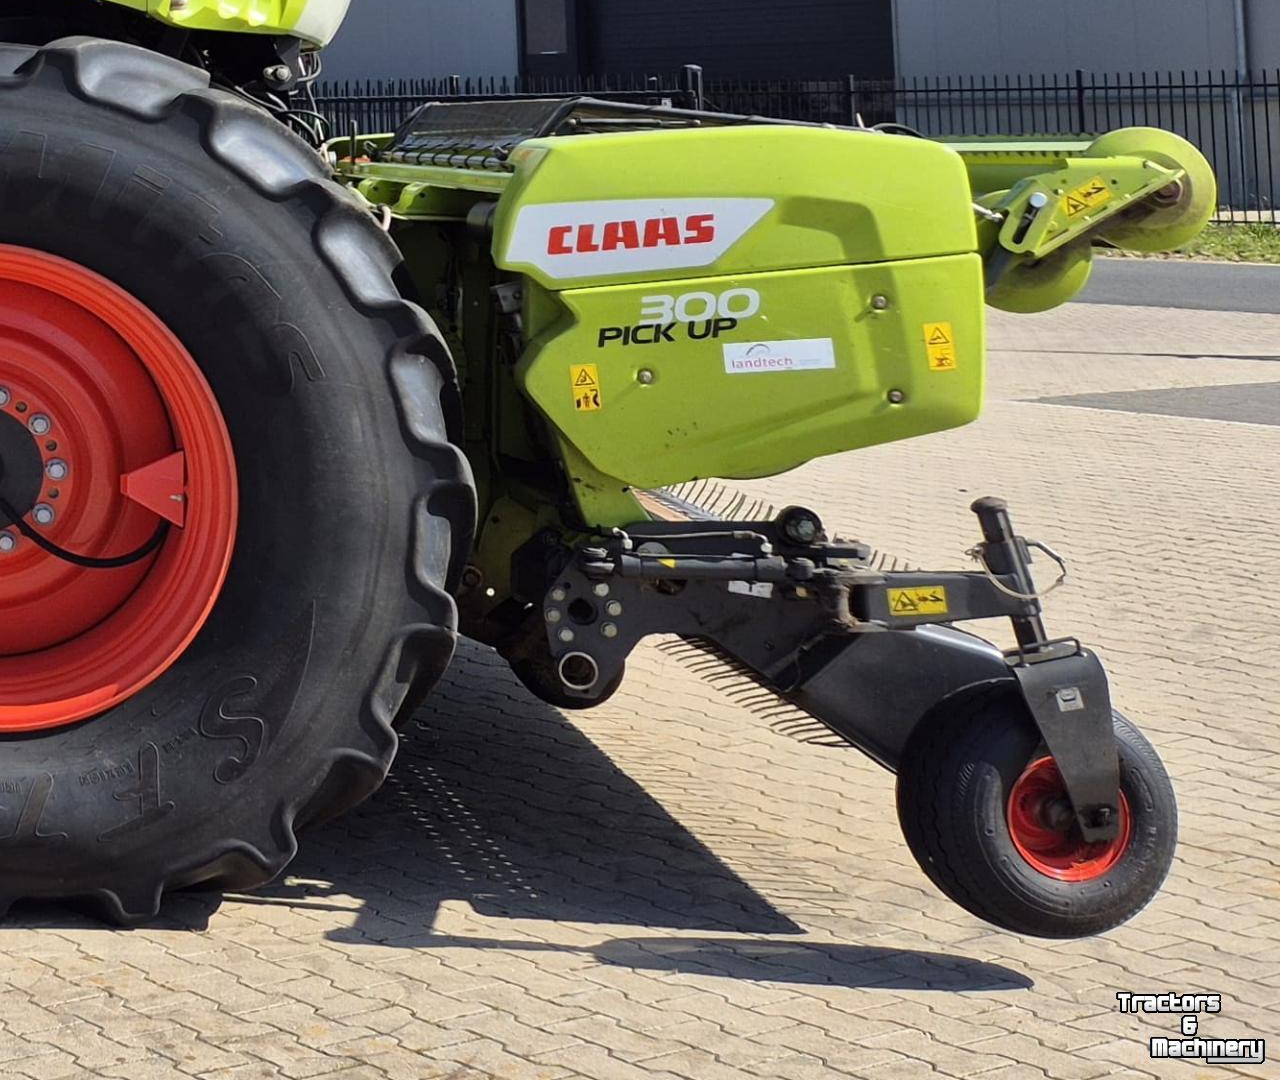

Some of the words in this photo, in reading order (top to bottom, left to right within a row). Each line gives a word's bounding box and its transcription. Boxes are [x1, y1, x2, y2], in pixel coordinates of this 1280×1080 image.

[547, 213, 715, 255] CLAAS
[639, 288, 760, 325] 300
[598, 322, 676, 347] PICK
[688, 317, 737, 339] UP
[732, 356, 793, 369] landtech
